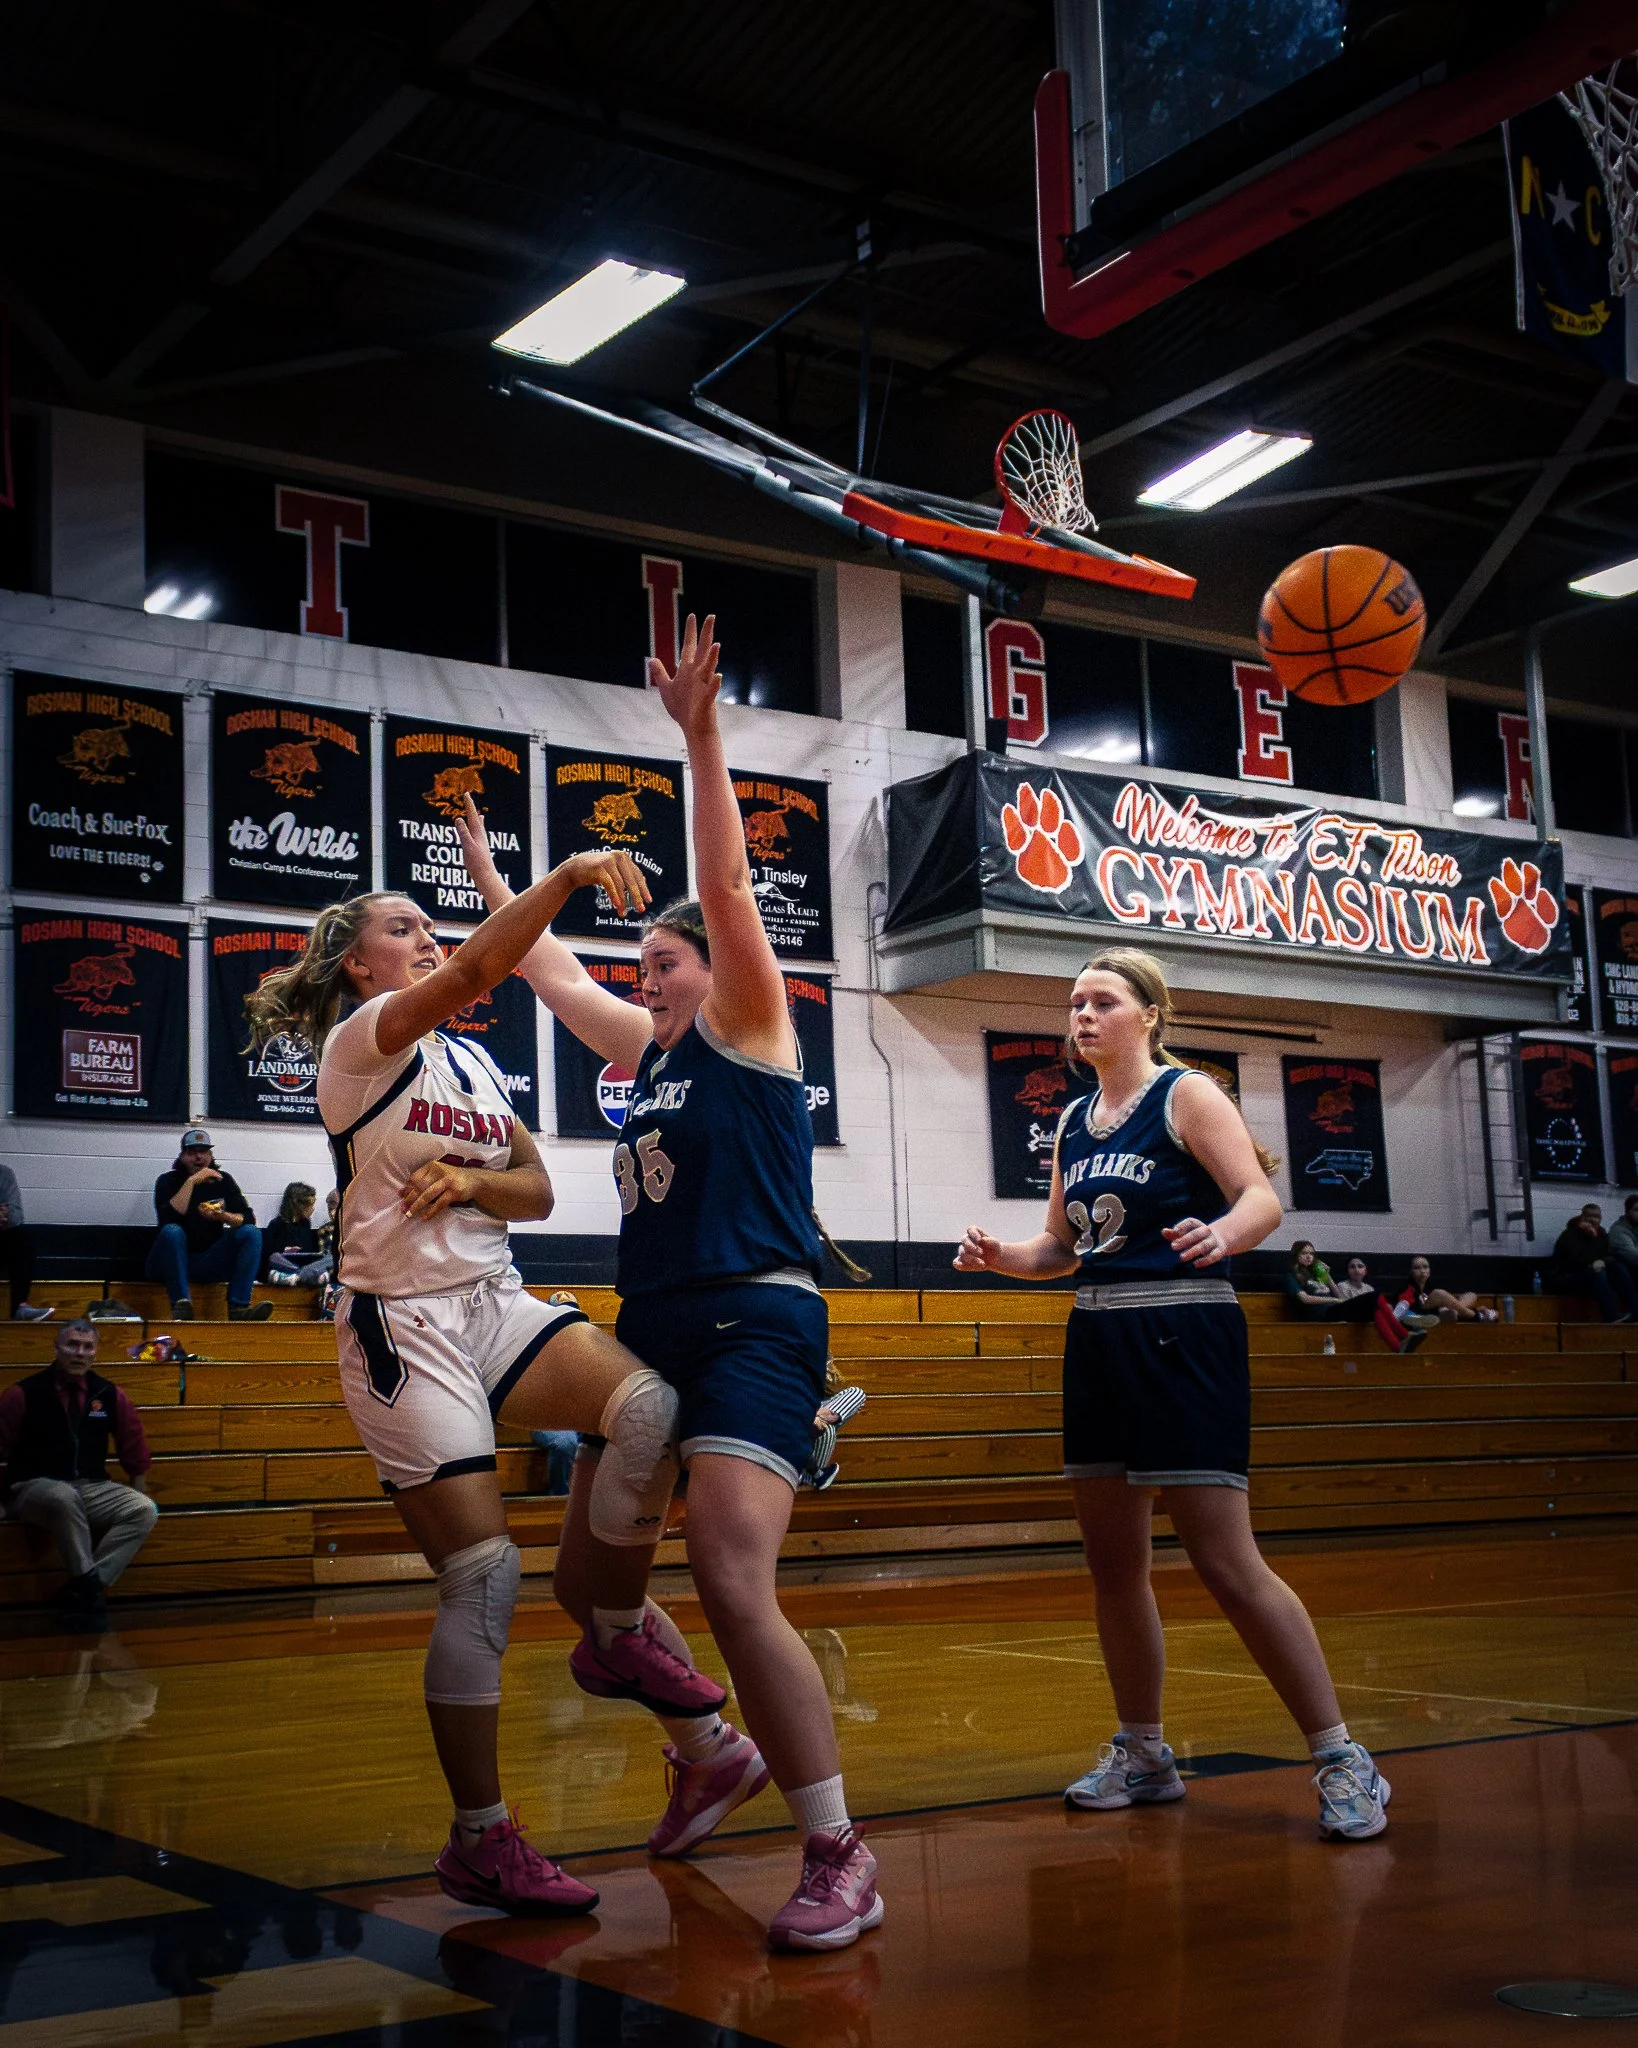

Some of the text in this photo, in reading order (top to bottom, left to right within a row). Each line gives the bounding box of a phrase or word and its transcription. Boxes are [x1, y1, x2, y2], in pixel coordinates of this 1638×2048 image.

[274, 483, 370, 640] T
[985, 617, 1048, 747] G
[26, 691, 174, 736] ROSMAN HIGH SCHOOL
[1232, 659, 1294, 786] E
[280, 709, 312, 736] HIGH
[312, 715, 360, 756] SCHOOL
[395, 732, 521, 776] ROSMAN HIGH SCHOOL
[556, 762, 676, 800] ROSMAN HIGH SCHOOL
[28, 801, 86, 837] Coach
[84, 812, 99, 835] &
[1112, 782, 1258, 855] Welcome
[1381, 828, 1462, 887] Tilson
[228, 811, 360, 861] the Wilds
[49, 844, 152, 869] LOVE THE TIGERS!
[229, 857, 359, 881] Christian Camp & Conference Center
[635, 848, 664, 876] Union
[761, 866, 808, 888] Tinsley
[437, 887, 485, 911] PARTY
[1097, 846, 1492, 965] GYMNASIUM
[21, 919, 183, 960] ROSMAN HIGH SCHOOL
[213, 931, 308, 956] ROSMAN HIGH
[610, 965, 638, 983] HIGH
[786, 977, 828, 1006] SCHOOL
[70, 1052, 135, 1071] BUREAU
[88, 1038, 134, 1055] FARM
[81, 1073, 134, 1085] INSURANCE
[247, 1060, 319, 1077] LANDMAR
